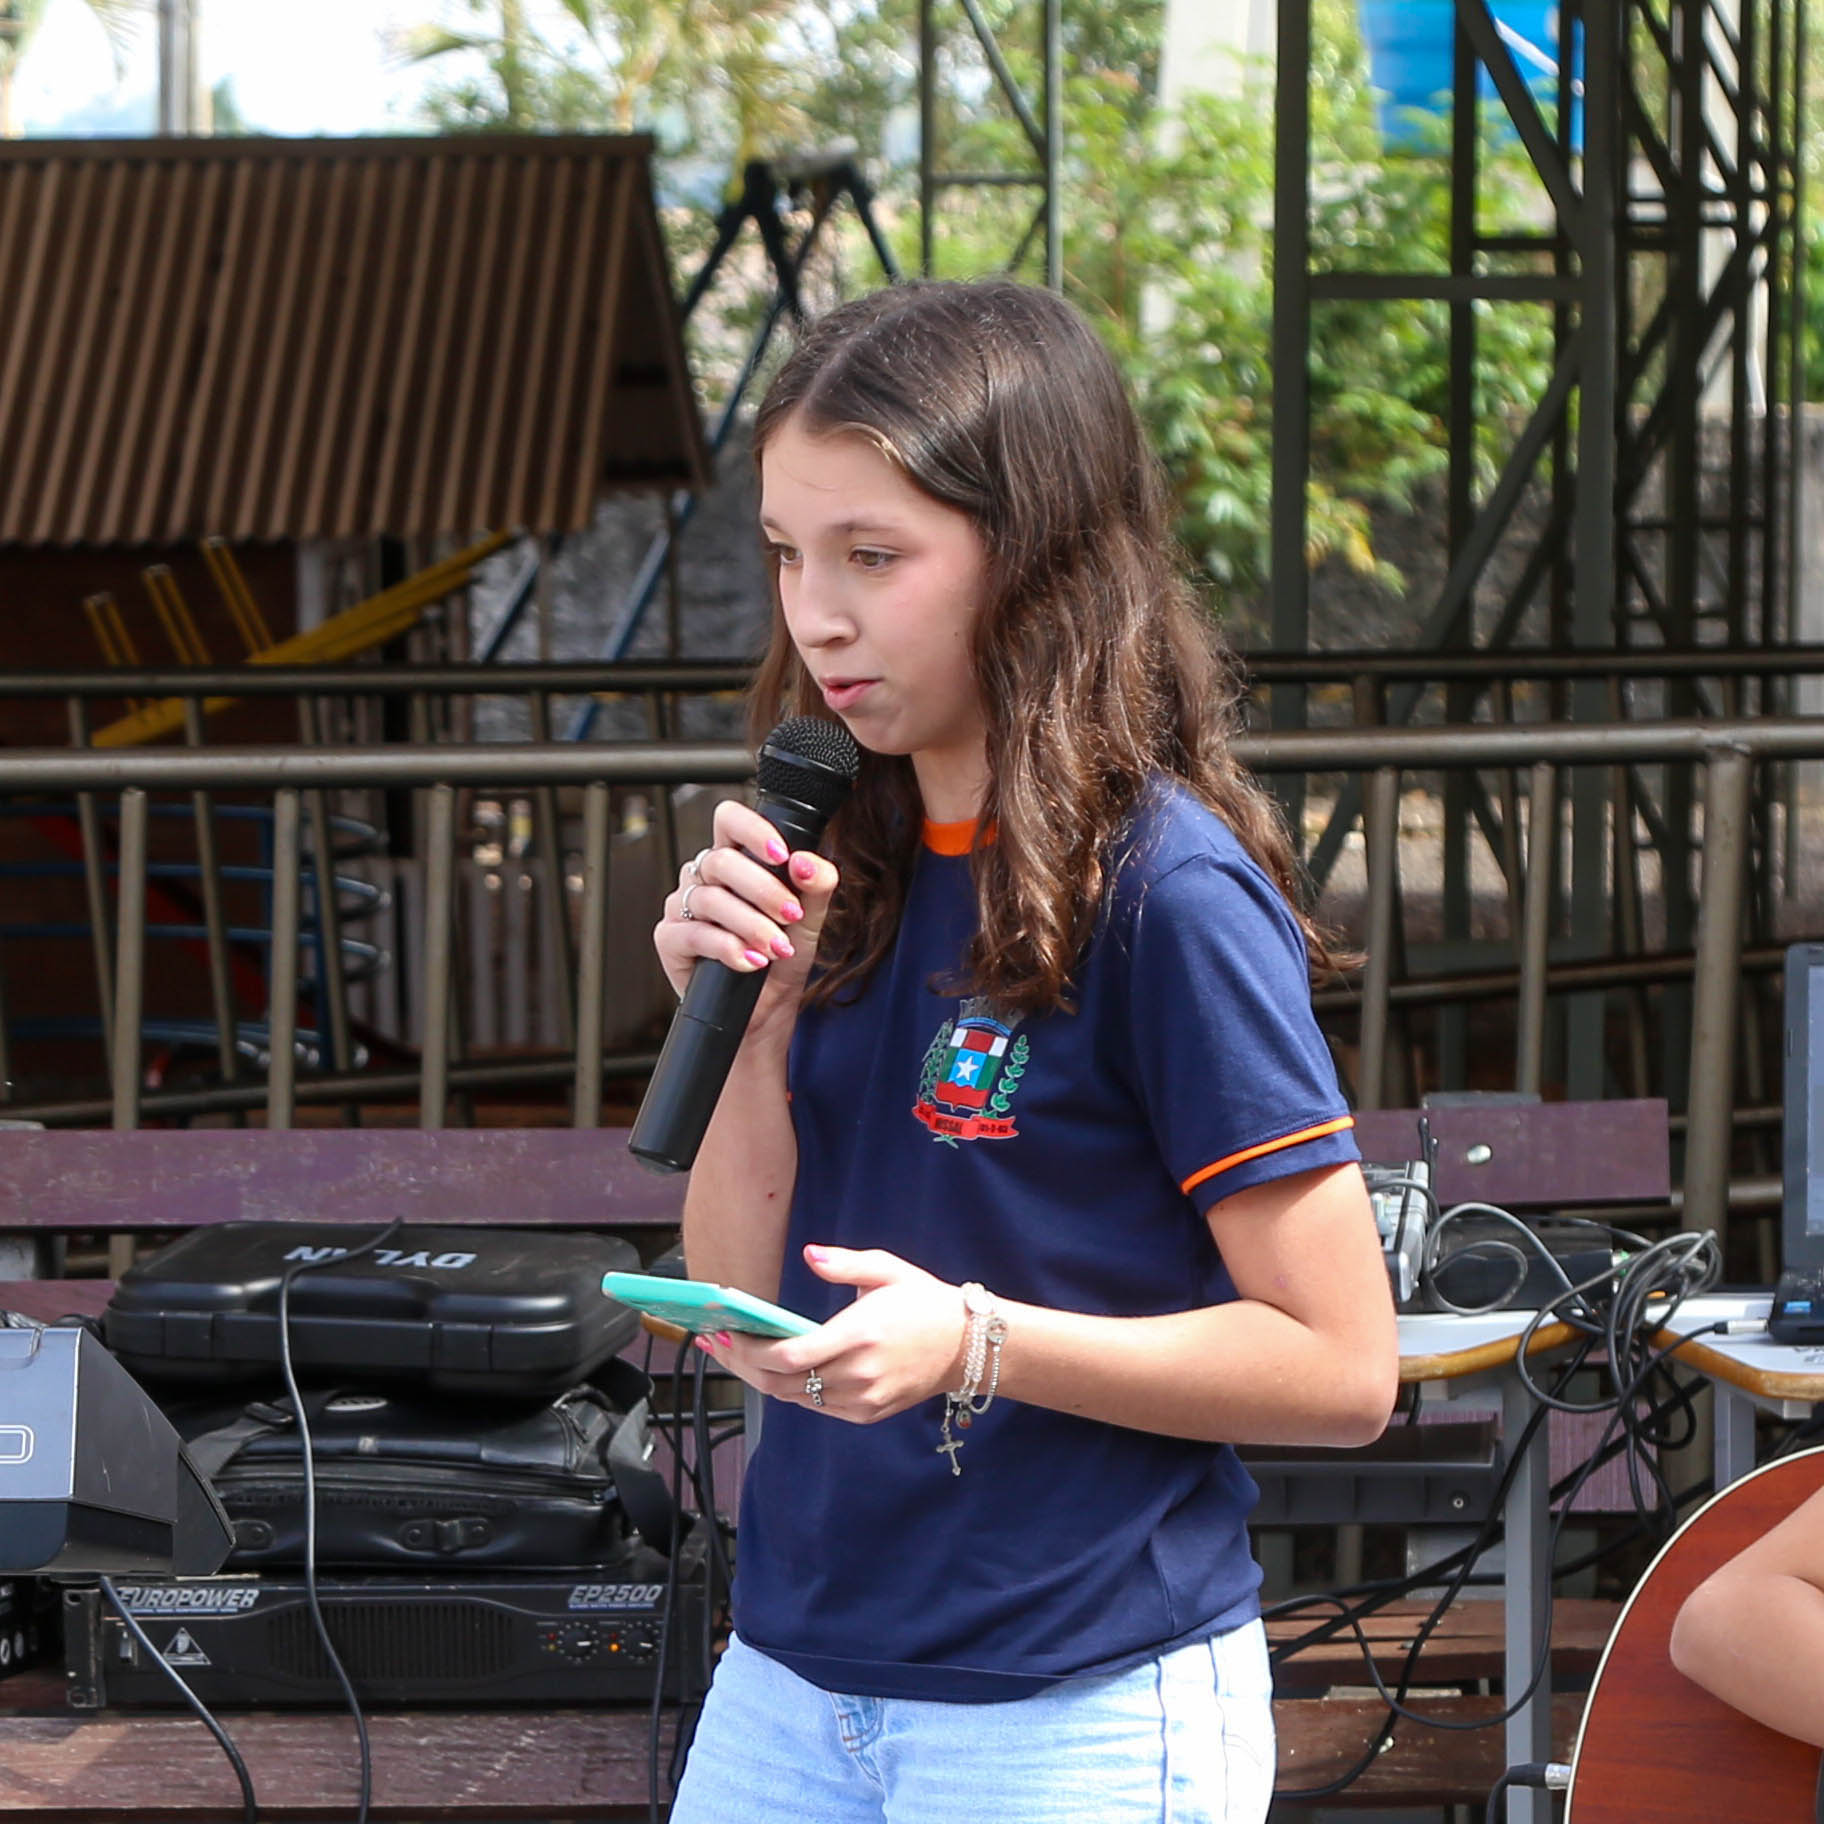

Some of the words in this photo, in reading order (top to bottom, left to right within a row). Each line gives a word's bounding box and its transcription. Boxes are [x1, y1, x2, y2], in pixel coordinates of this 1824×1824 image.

[282, 1245, 478, 1270] DYLN
[118, 1587, 260, 1609] EUROPOWER
[568, 1584, 664, 1606] EP2500
